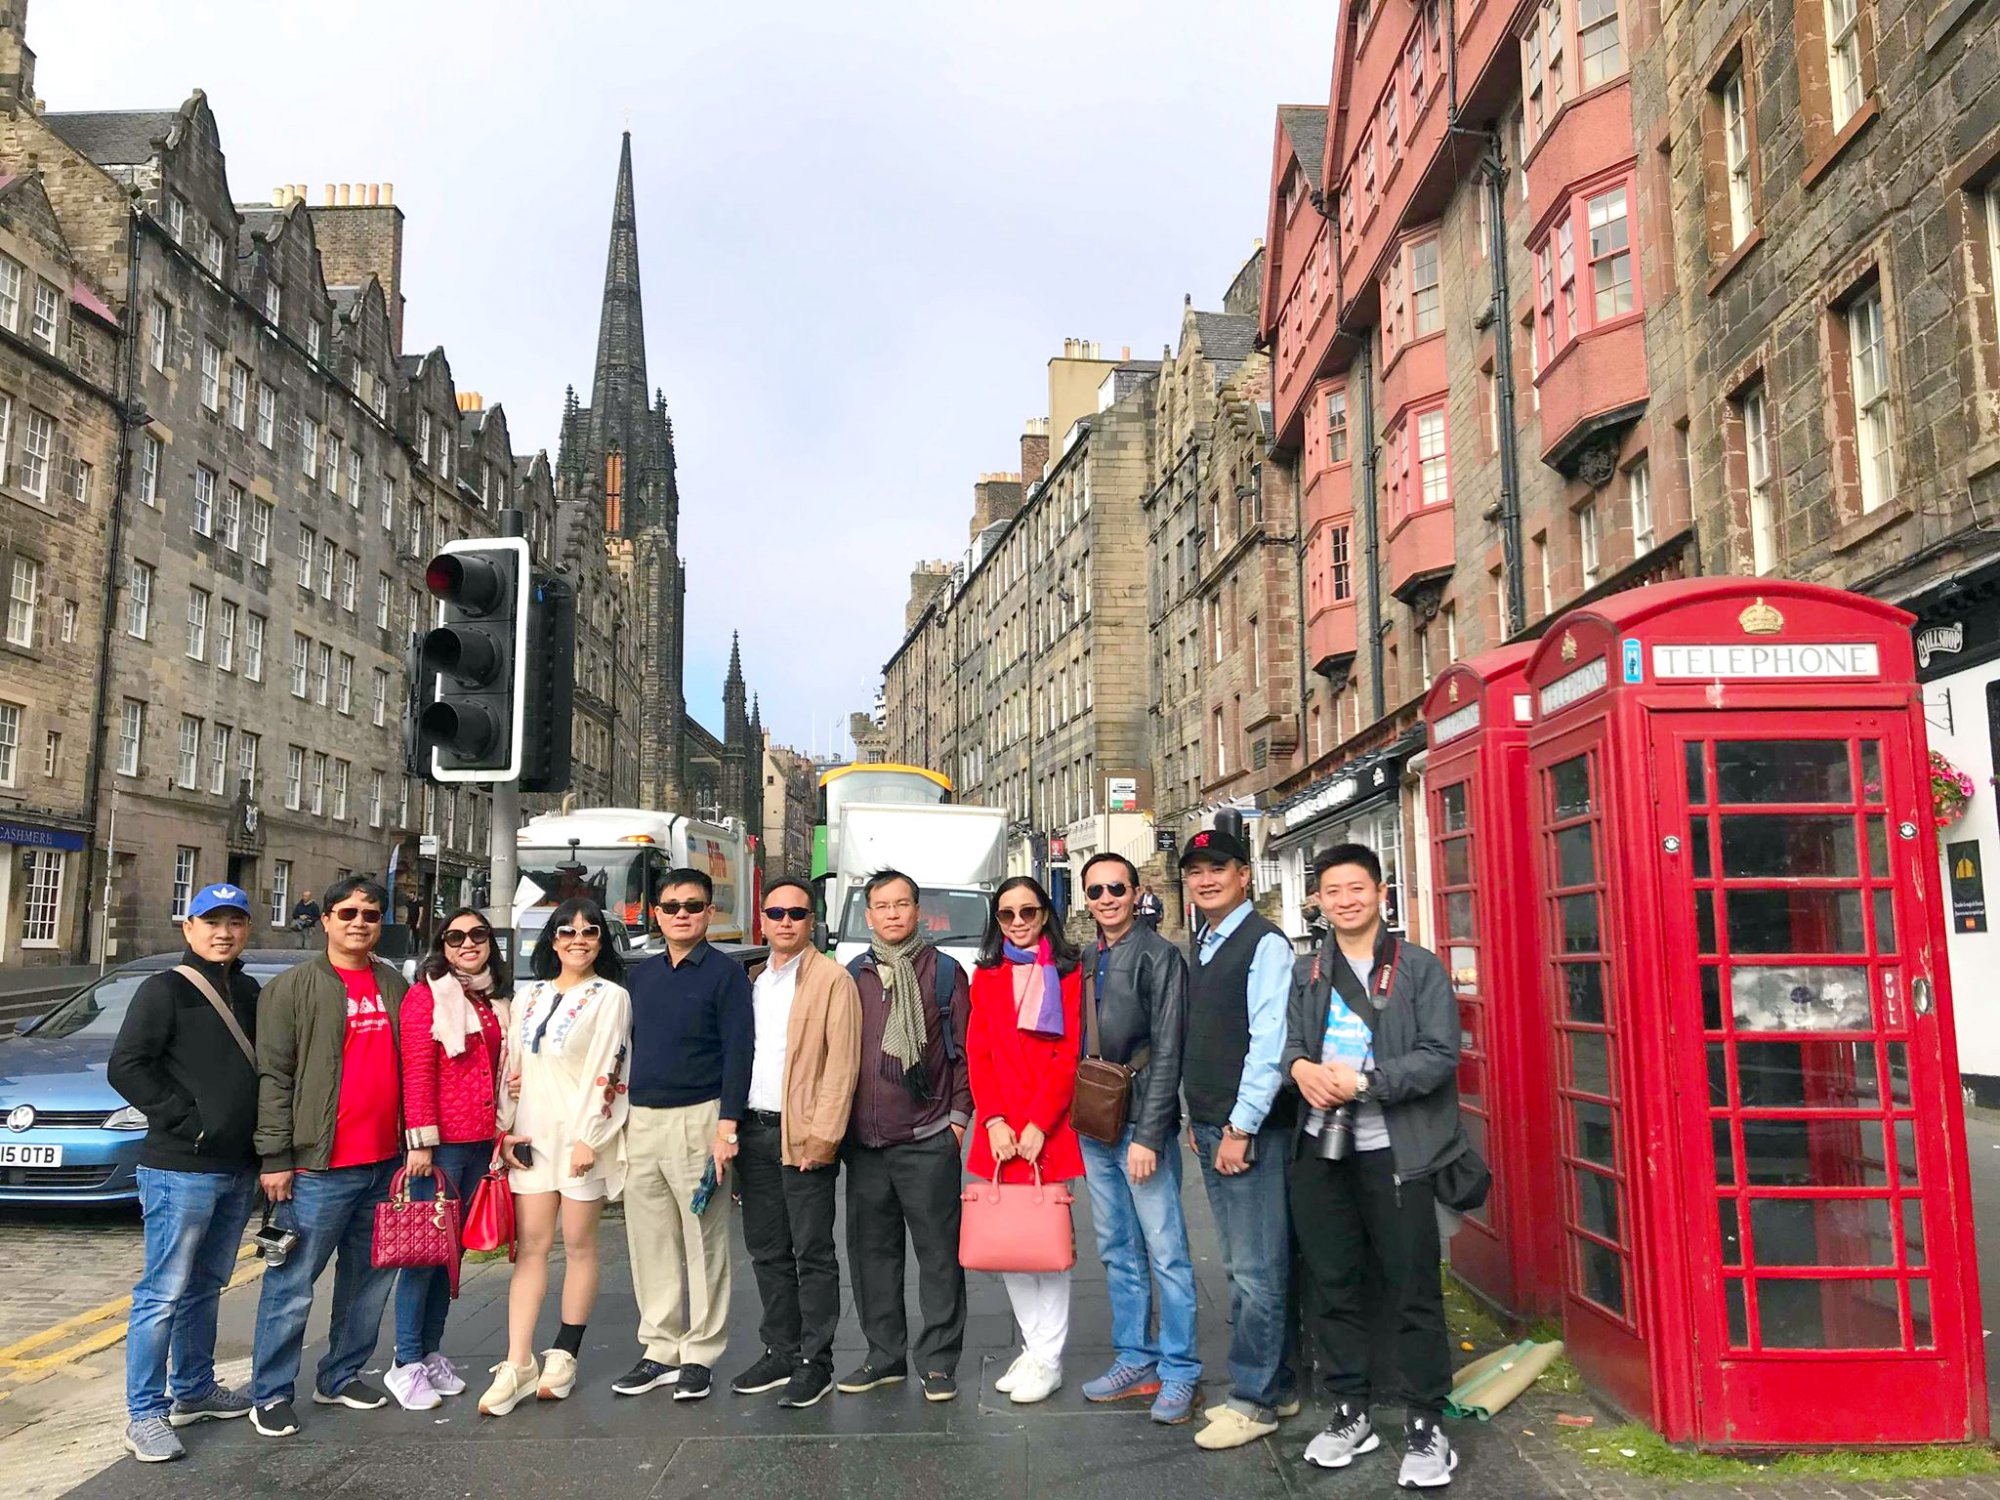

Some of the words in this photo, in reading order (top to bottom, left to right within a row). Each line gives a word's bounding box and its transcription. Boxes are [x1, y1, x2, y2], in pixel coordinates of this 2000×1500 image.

[1661, 647, 1868, 674] TELEPHONE
[1884, 973, 1897, 1025] PULL
[21, 1147, 55, 1163] OTB
